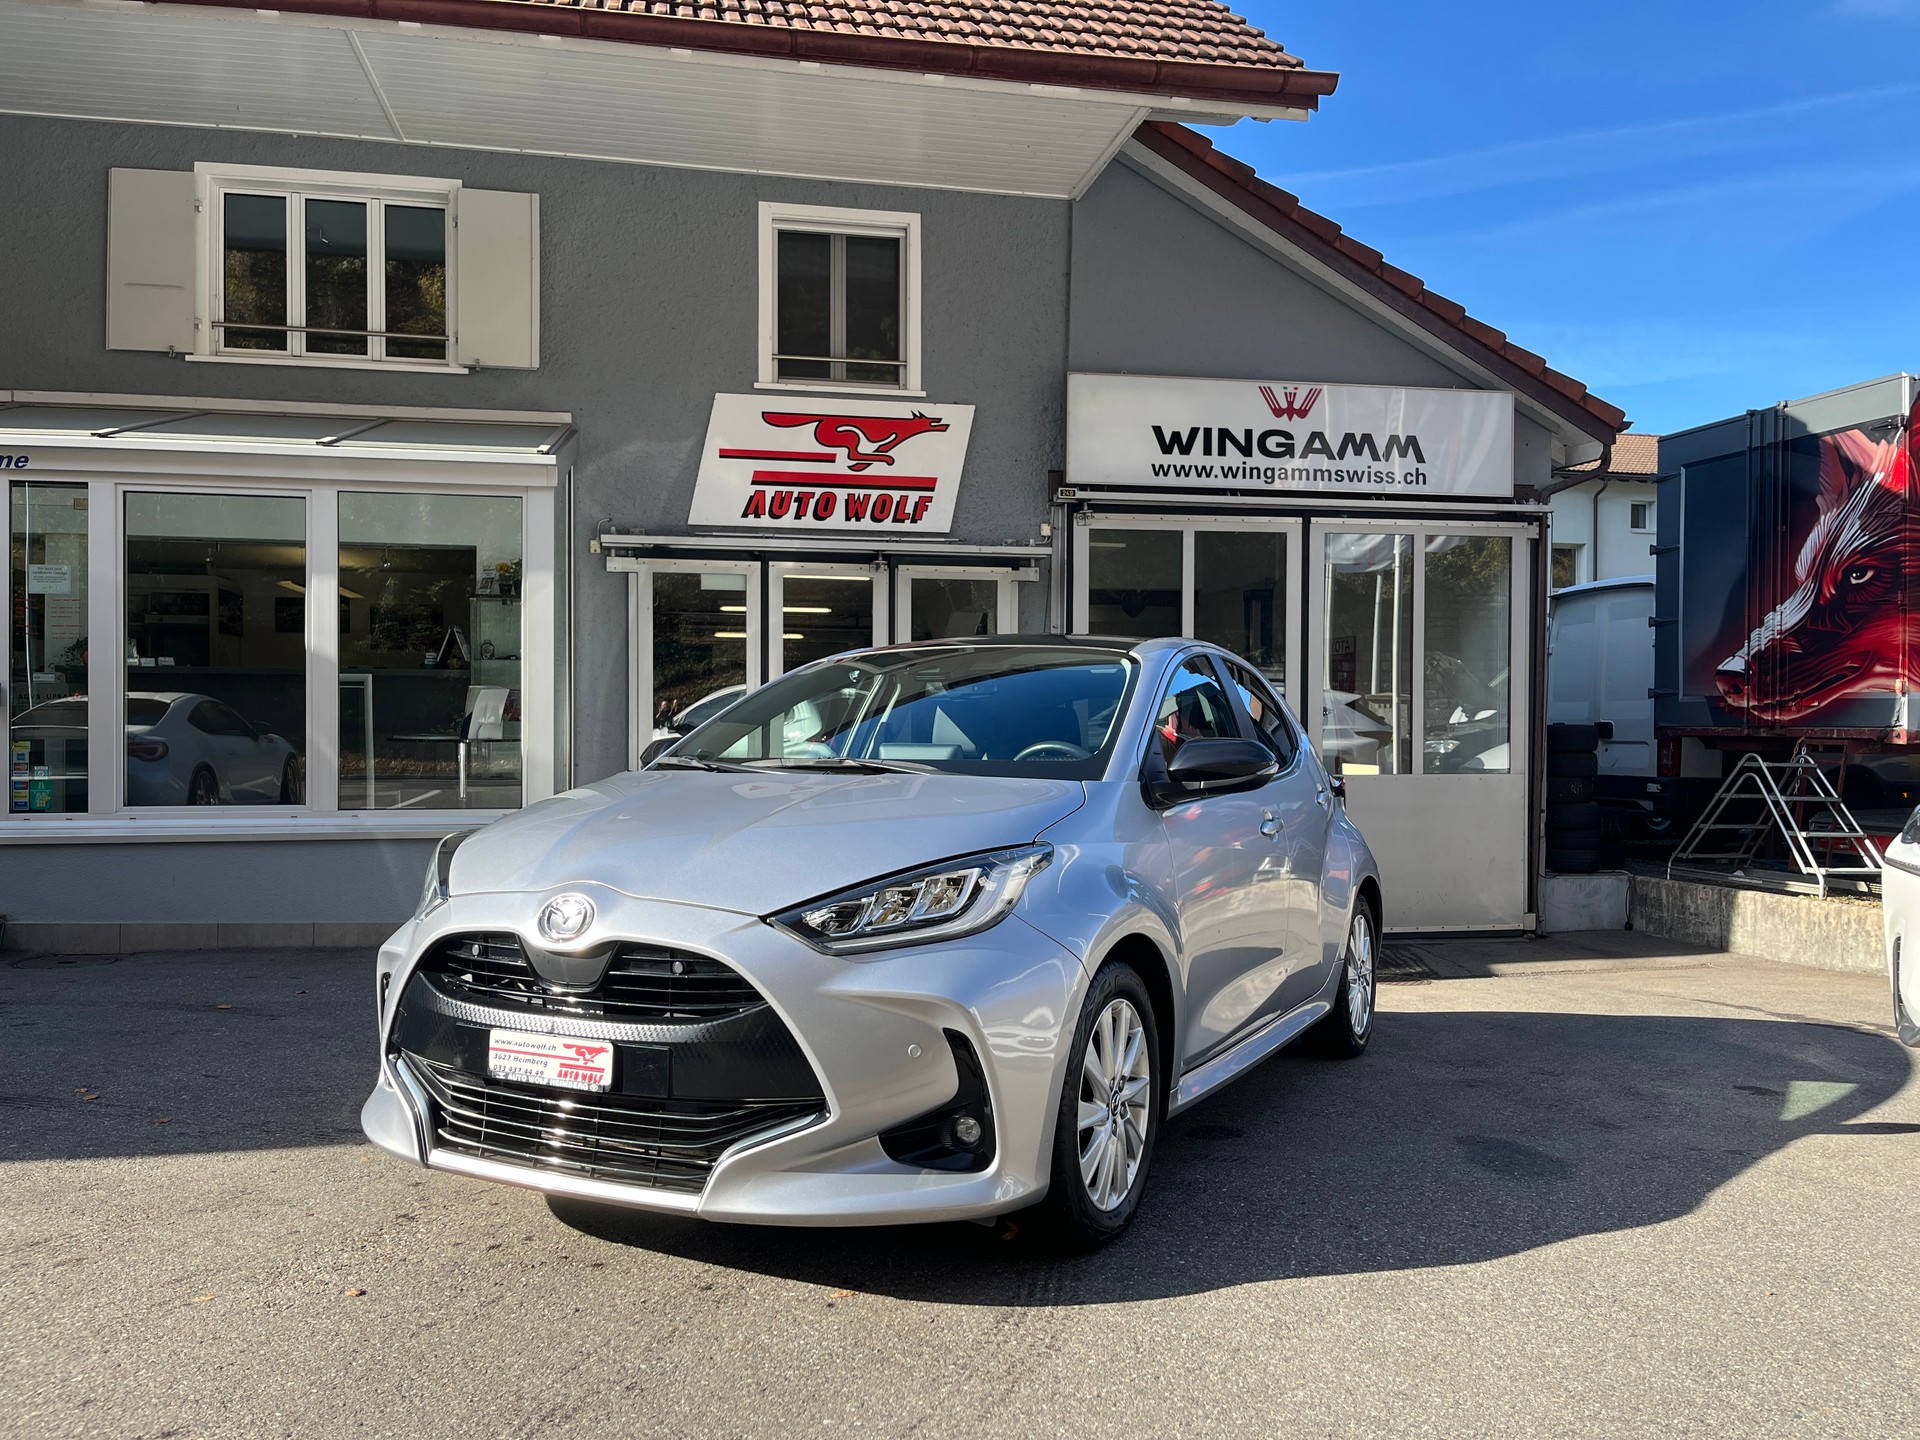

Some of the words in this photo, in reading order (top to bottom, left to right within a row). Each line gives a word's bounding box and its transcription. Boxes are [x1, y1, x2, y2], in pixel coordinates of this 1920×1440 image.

[1151, 424, 1427, 465] WINGAMM
[1151, 461, 1428, 487] www.wingammswiss.ch
[741, 489, 838, 522] AUTO
[845, 492, 934, 524] WOLF
[494, 1038, 557, 1051] www.autowolf.ch
[493, 1053, 511, 1061] 3627
[513, 1055, 548, 1067] Heimberg
[507, 1073, 528, 1082] AUTO
[529, 1075, 549, 1085] WOLF
[557, 1069, 580, 1081] AUTO
[581, 1071, 604, 1084] WOLF
